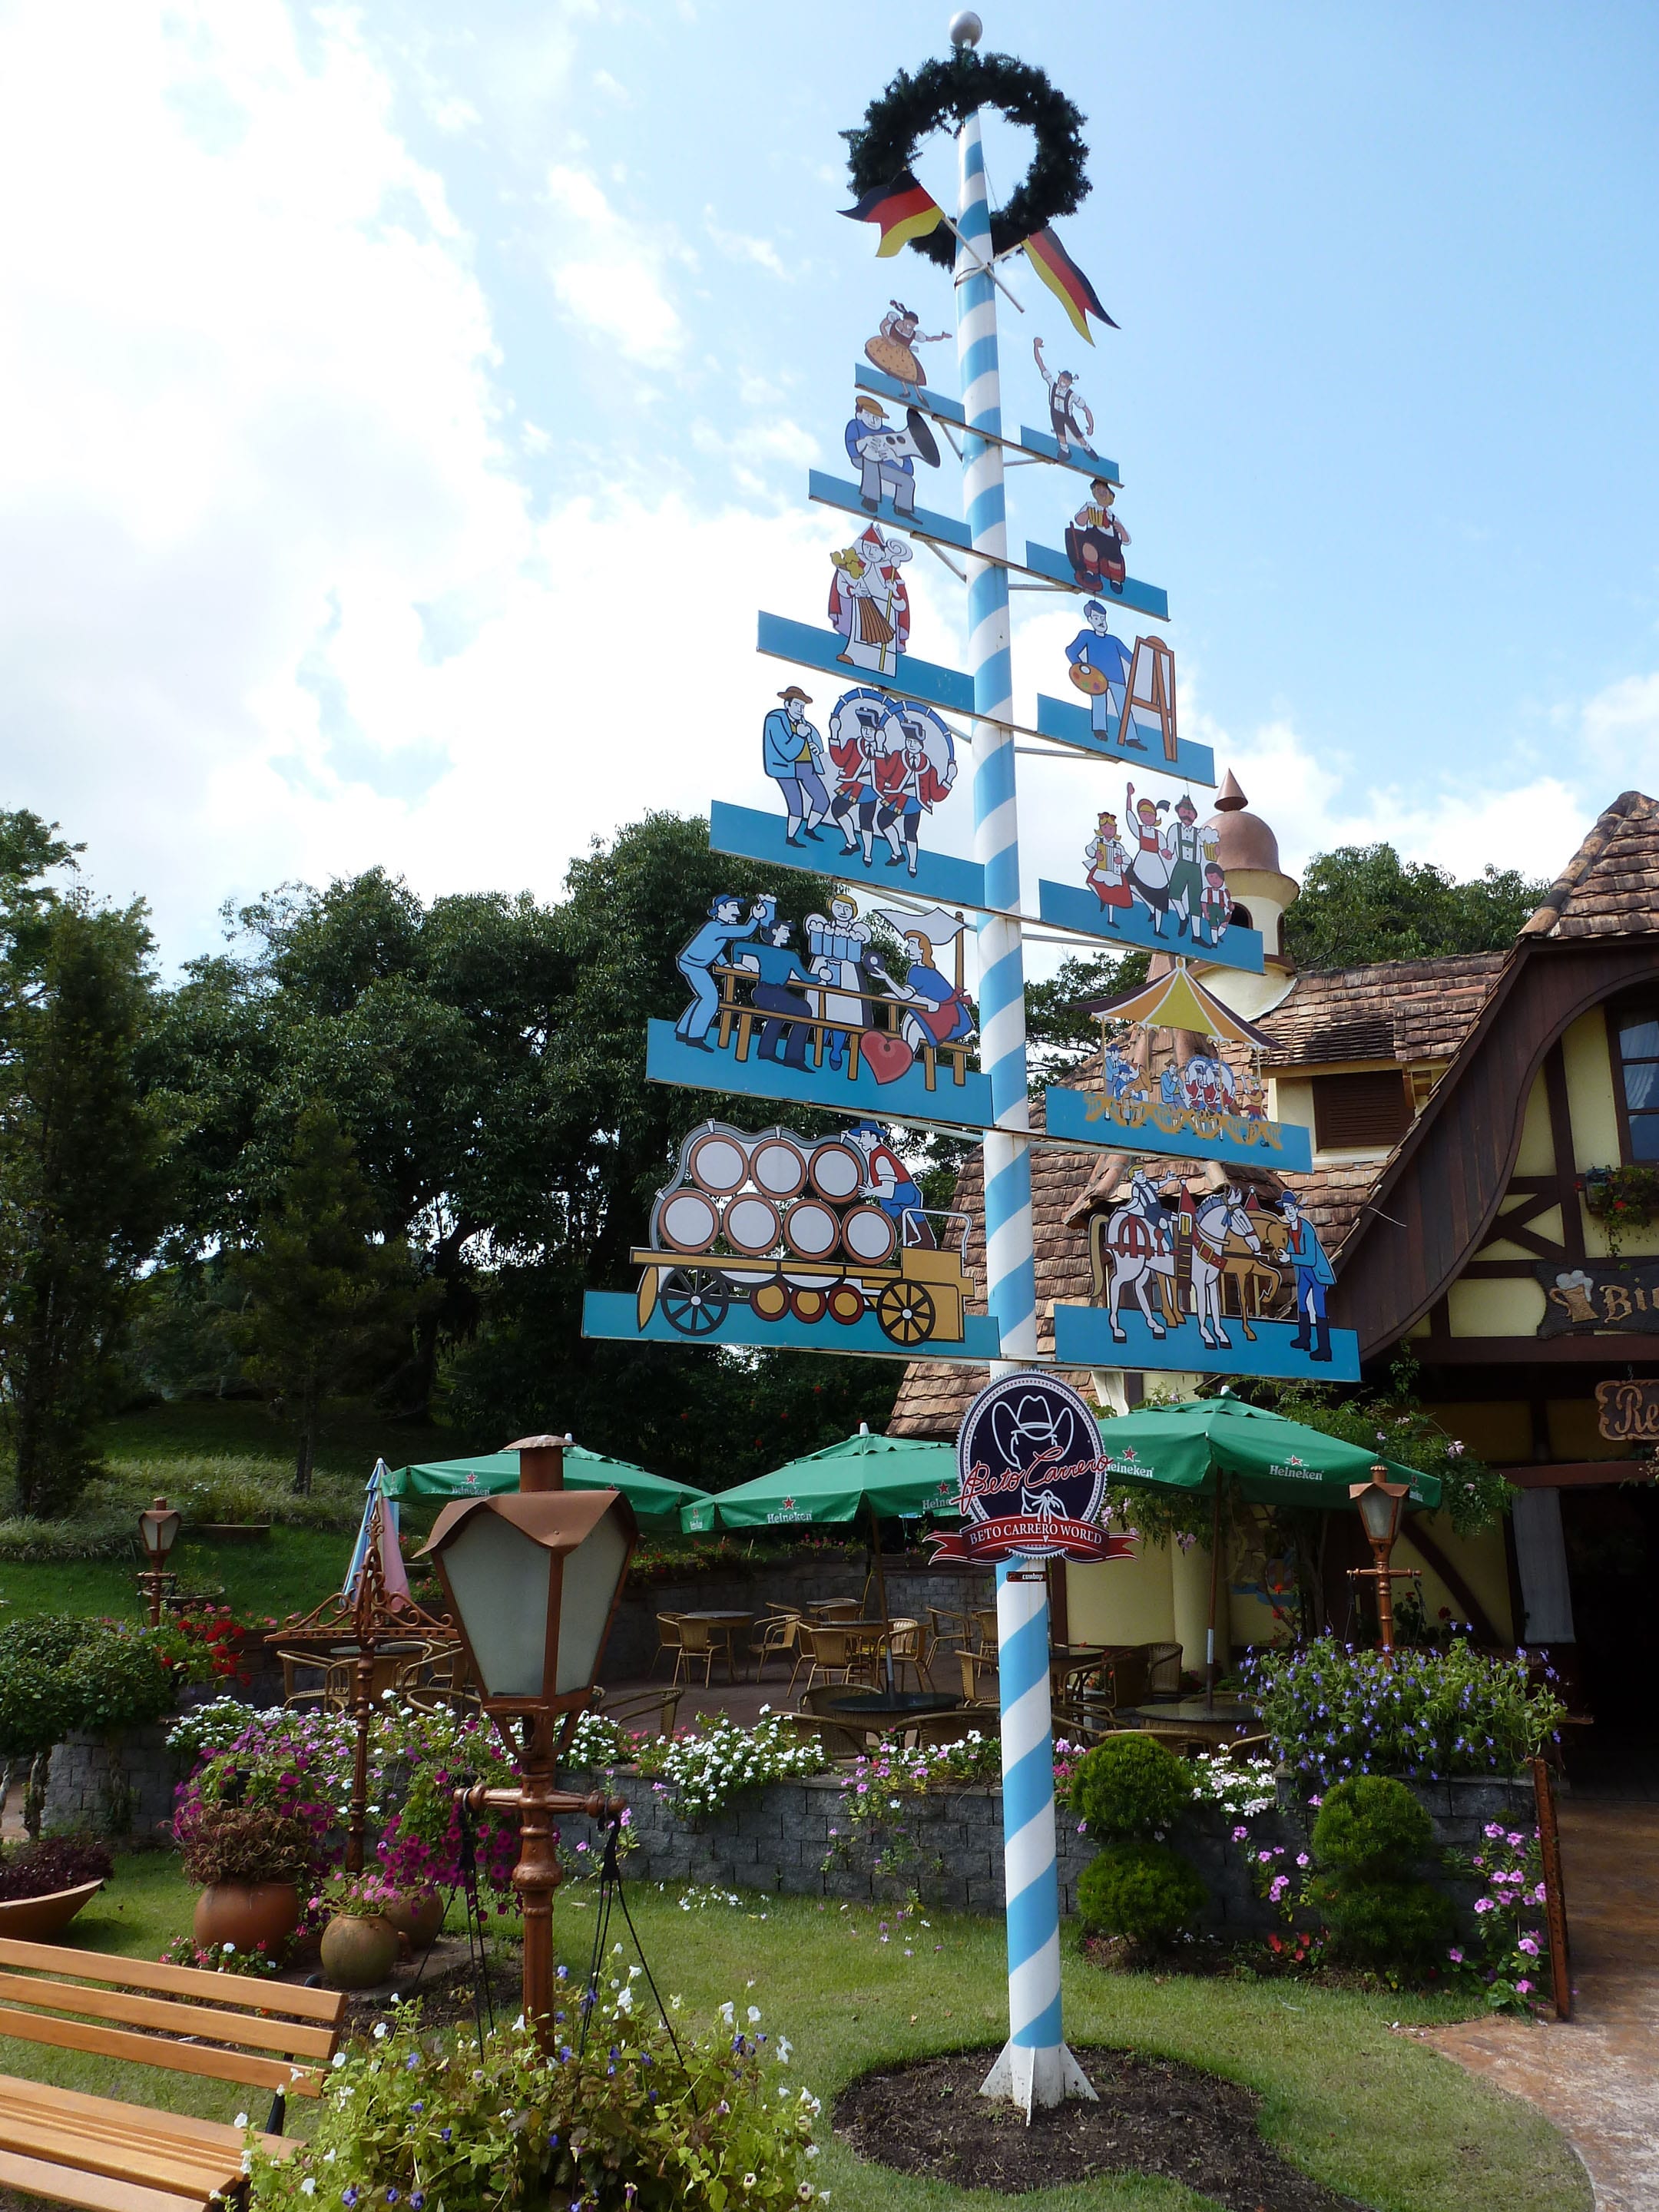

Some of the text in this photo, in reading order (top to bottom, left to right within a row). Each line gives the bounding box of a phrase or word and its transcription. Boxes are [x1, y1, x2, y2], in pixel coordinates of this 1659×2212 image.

[950, 1445, 1114, 1517] Beto Carrero
[1269, 1465, 1323, 1481] Heineken
[767, 1512, 813, 1524] Heineken
[969, 1523, 1103, 1545] BETO CARRERO WORLD
